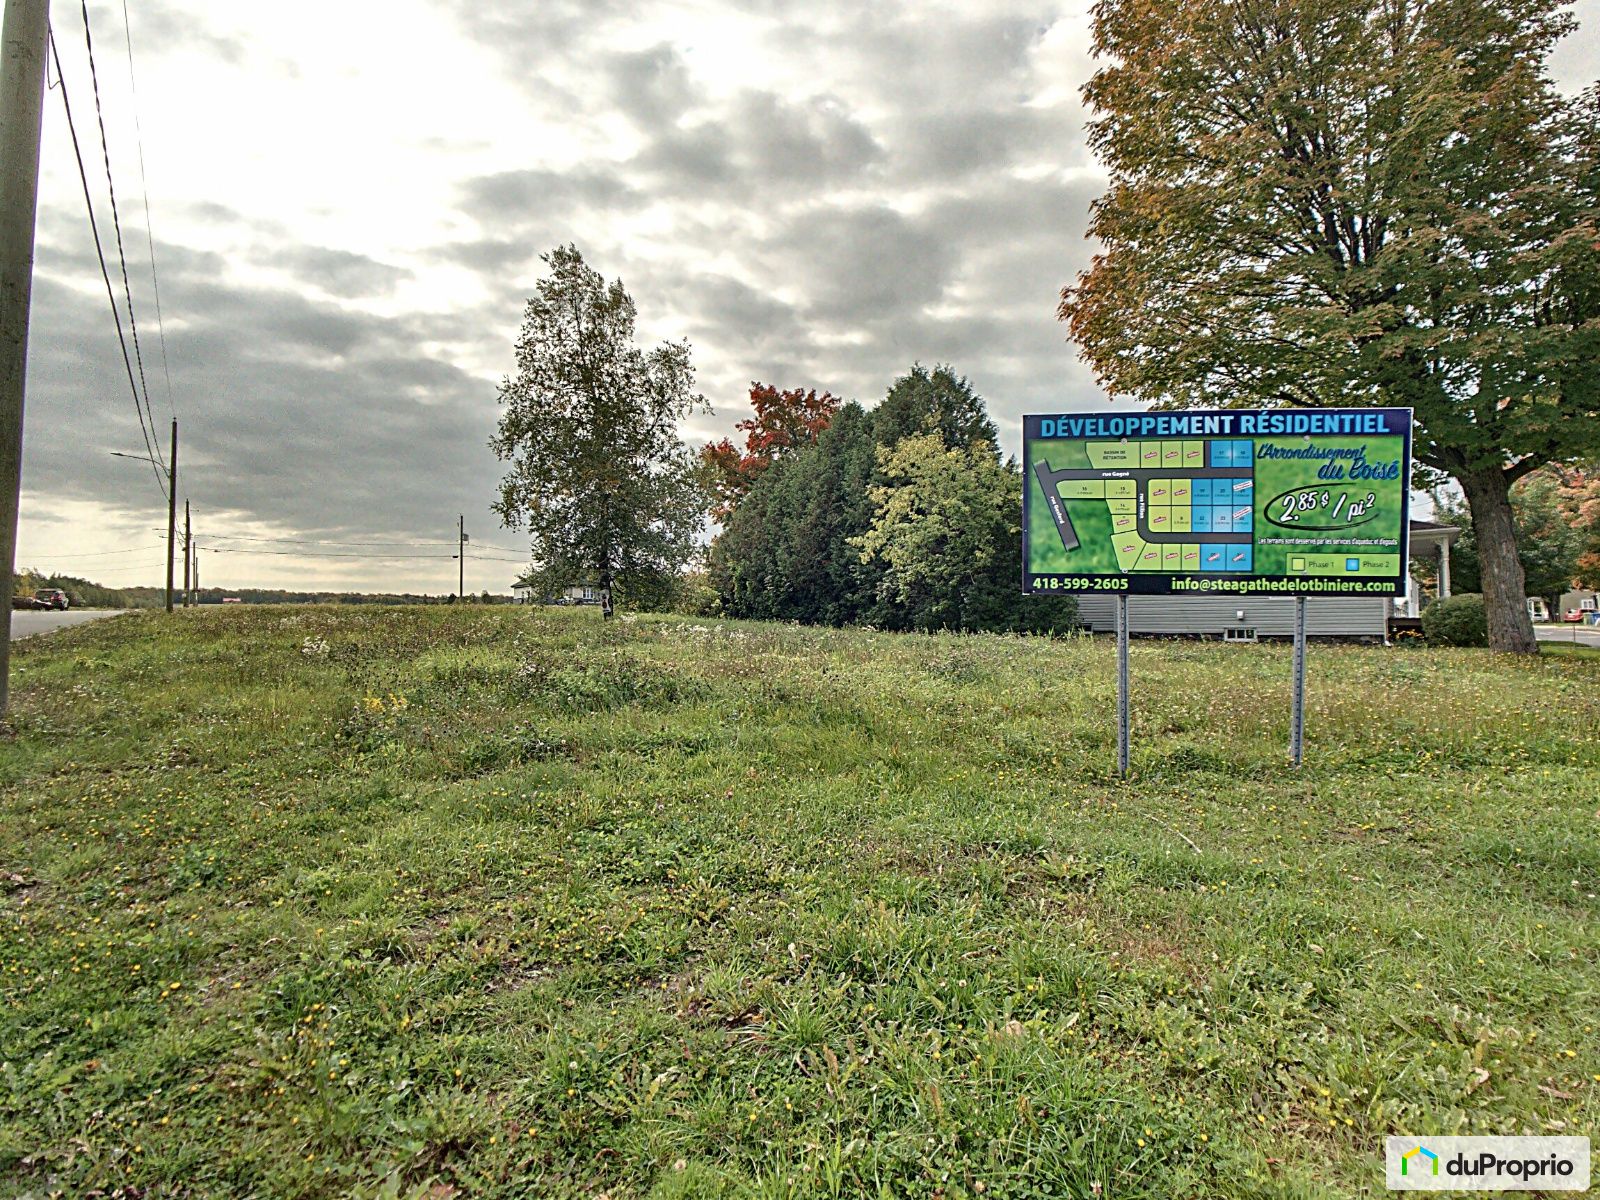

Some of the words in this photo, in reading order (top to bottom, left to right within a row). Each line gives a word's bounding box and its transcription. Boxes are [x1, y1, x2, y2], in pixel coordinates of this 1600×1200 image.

[1041, 415, 1234, 437] DÉVELOPPEMENT
[1240, 411, 1390, 434] RÉSIDENTIEL
[1257, 443, 1366, 459] L'Arrondissement
[1317, 458, 1345, 480] du
[1348, 457, 1400, 480] Boisé
[1033, 578, 1129, 590] 418-599-2605
[1171, 577, 1396, 593] info@steagathedelotbiniere.com
